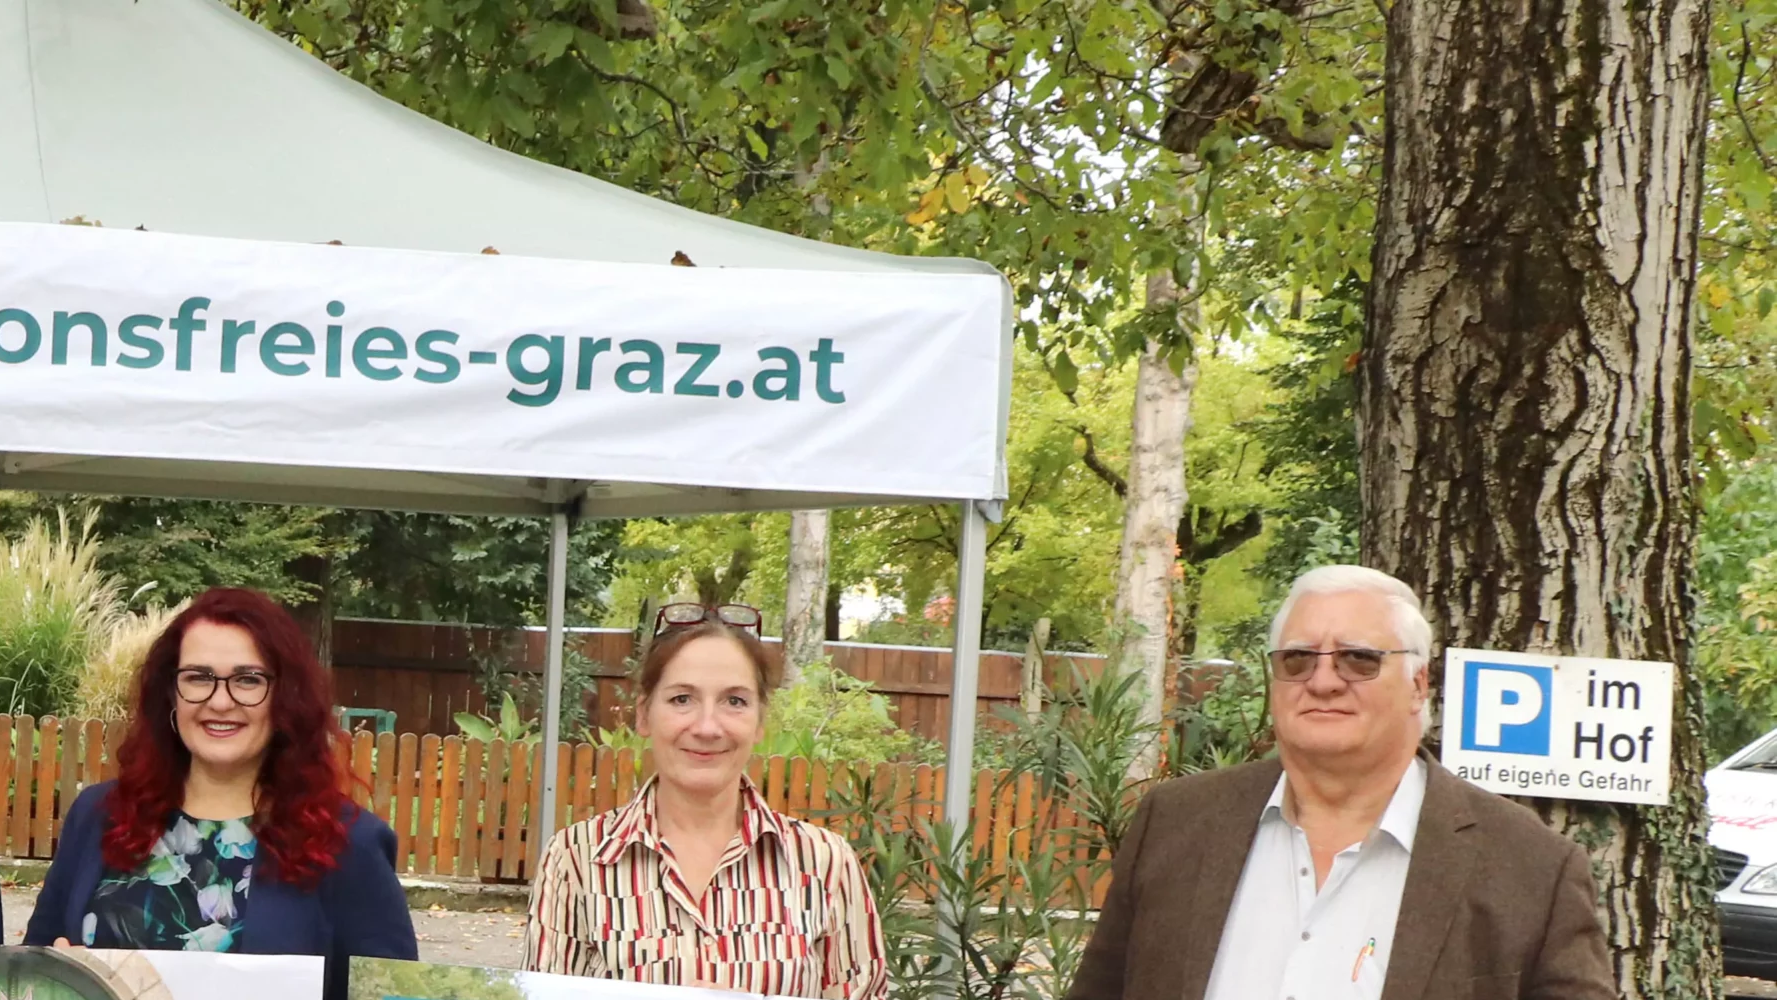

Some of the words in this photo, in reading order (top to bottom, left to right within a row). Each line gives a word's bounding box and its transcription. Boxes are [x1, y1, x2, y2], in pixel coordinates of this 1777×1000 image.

[1474, 668, 1543, 747] P
[1588, 669, 1641, 710] im
[1574, 721, 1654, 763] Hof
[1457, 763, 1491, 781] auf
[1498, 764, 1571, 789] eigene
[1578, 769, 1653, 792] Gefahr
